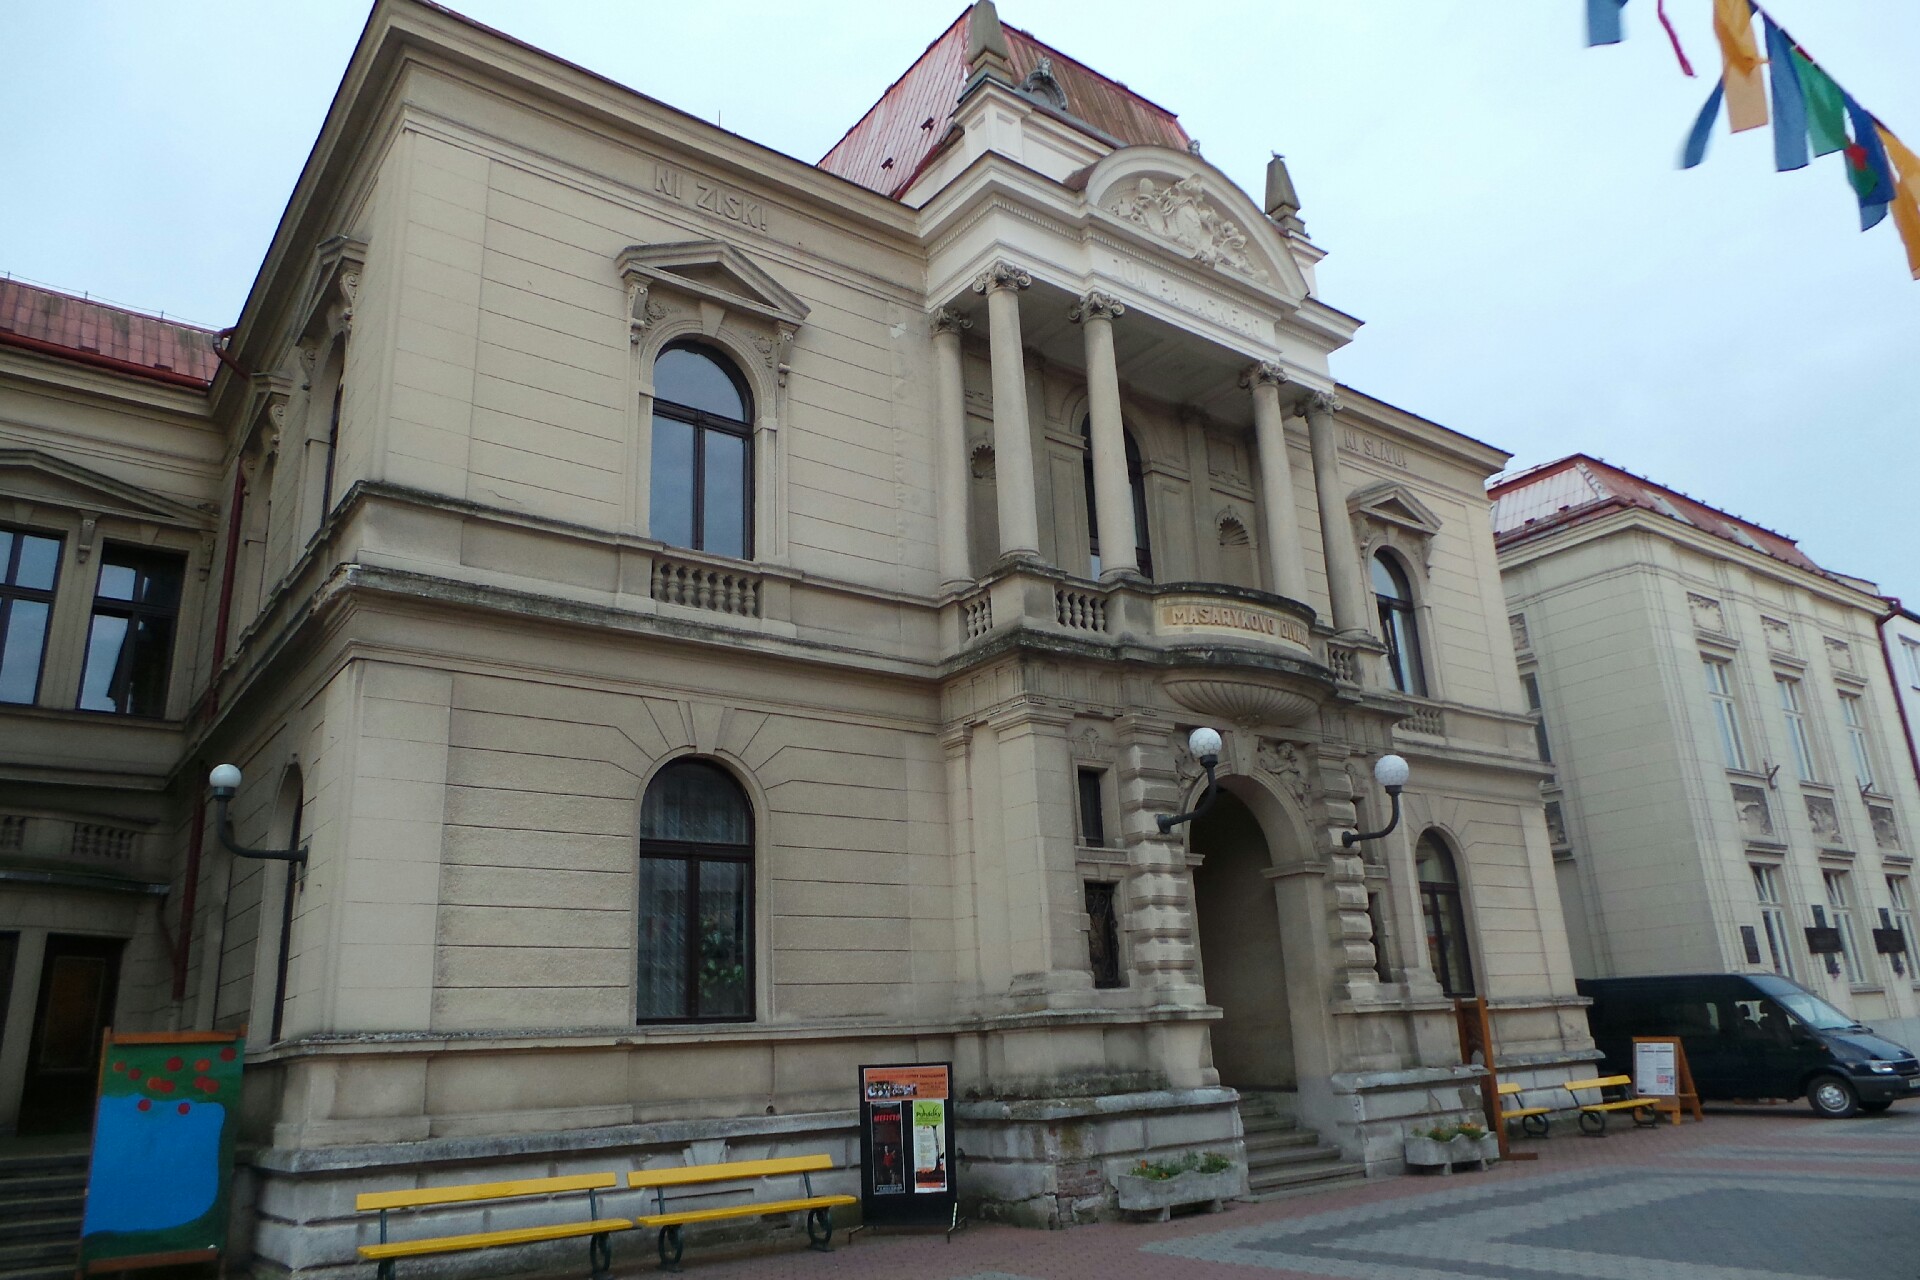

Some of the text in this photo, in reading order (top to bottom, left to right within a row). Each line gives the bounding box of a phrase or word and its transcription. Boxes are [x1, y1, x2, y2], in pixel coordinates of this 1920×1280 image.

[654, 165, 767, 232] NI ZISK!
[1172, 607, 1311, 650] MASARYKOVO DIVADL
